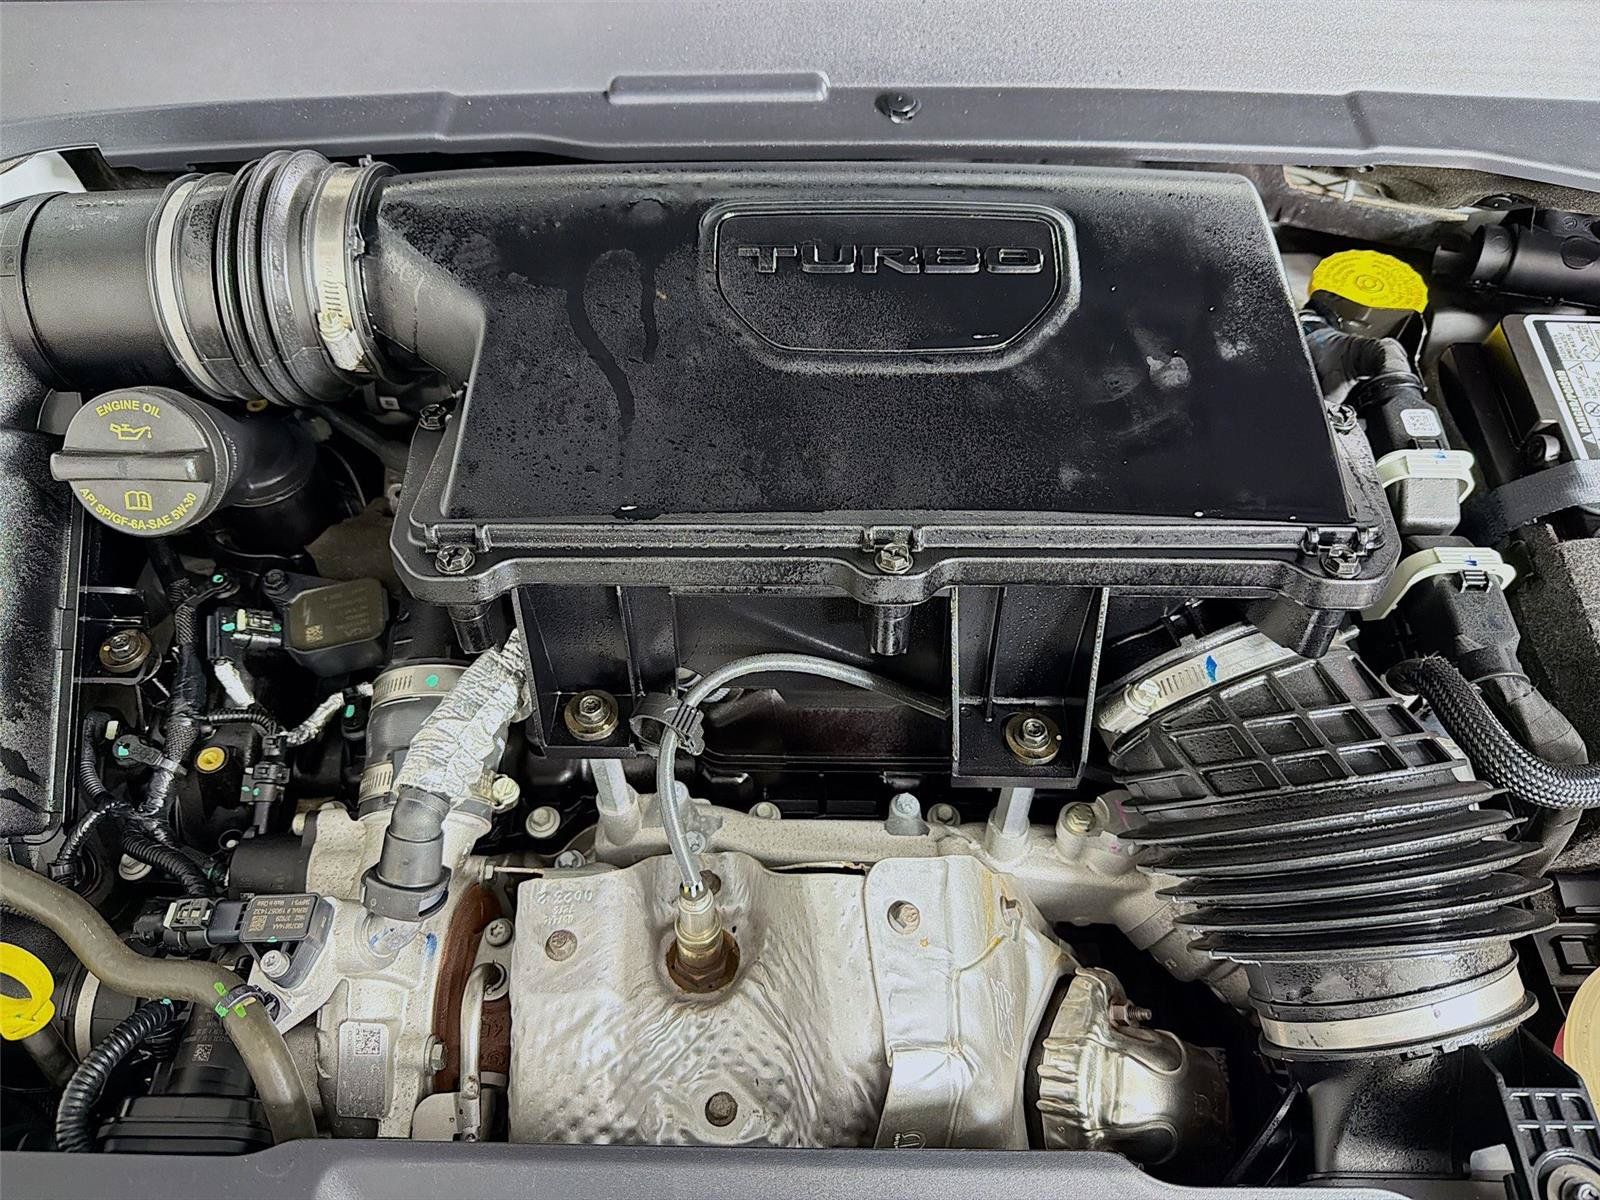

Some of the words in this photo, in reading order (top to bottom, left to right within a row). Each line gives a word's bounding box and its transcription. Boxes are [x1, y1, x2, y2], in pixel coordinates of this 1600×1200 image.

[737, 244, 1045, 274] TURBO
[96, 400, 139, 417] ENGINE
[143, 403, 161, 418] OIL
[79, 488, 97, 506] API
[173, 494, 197, 520] 5W-30
